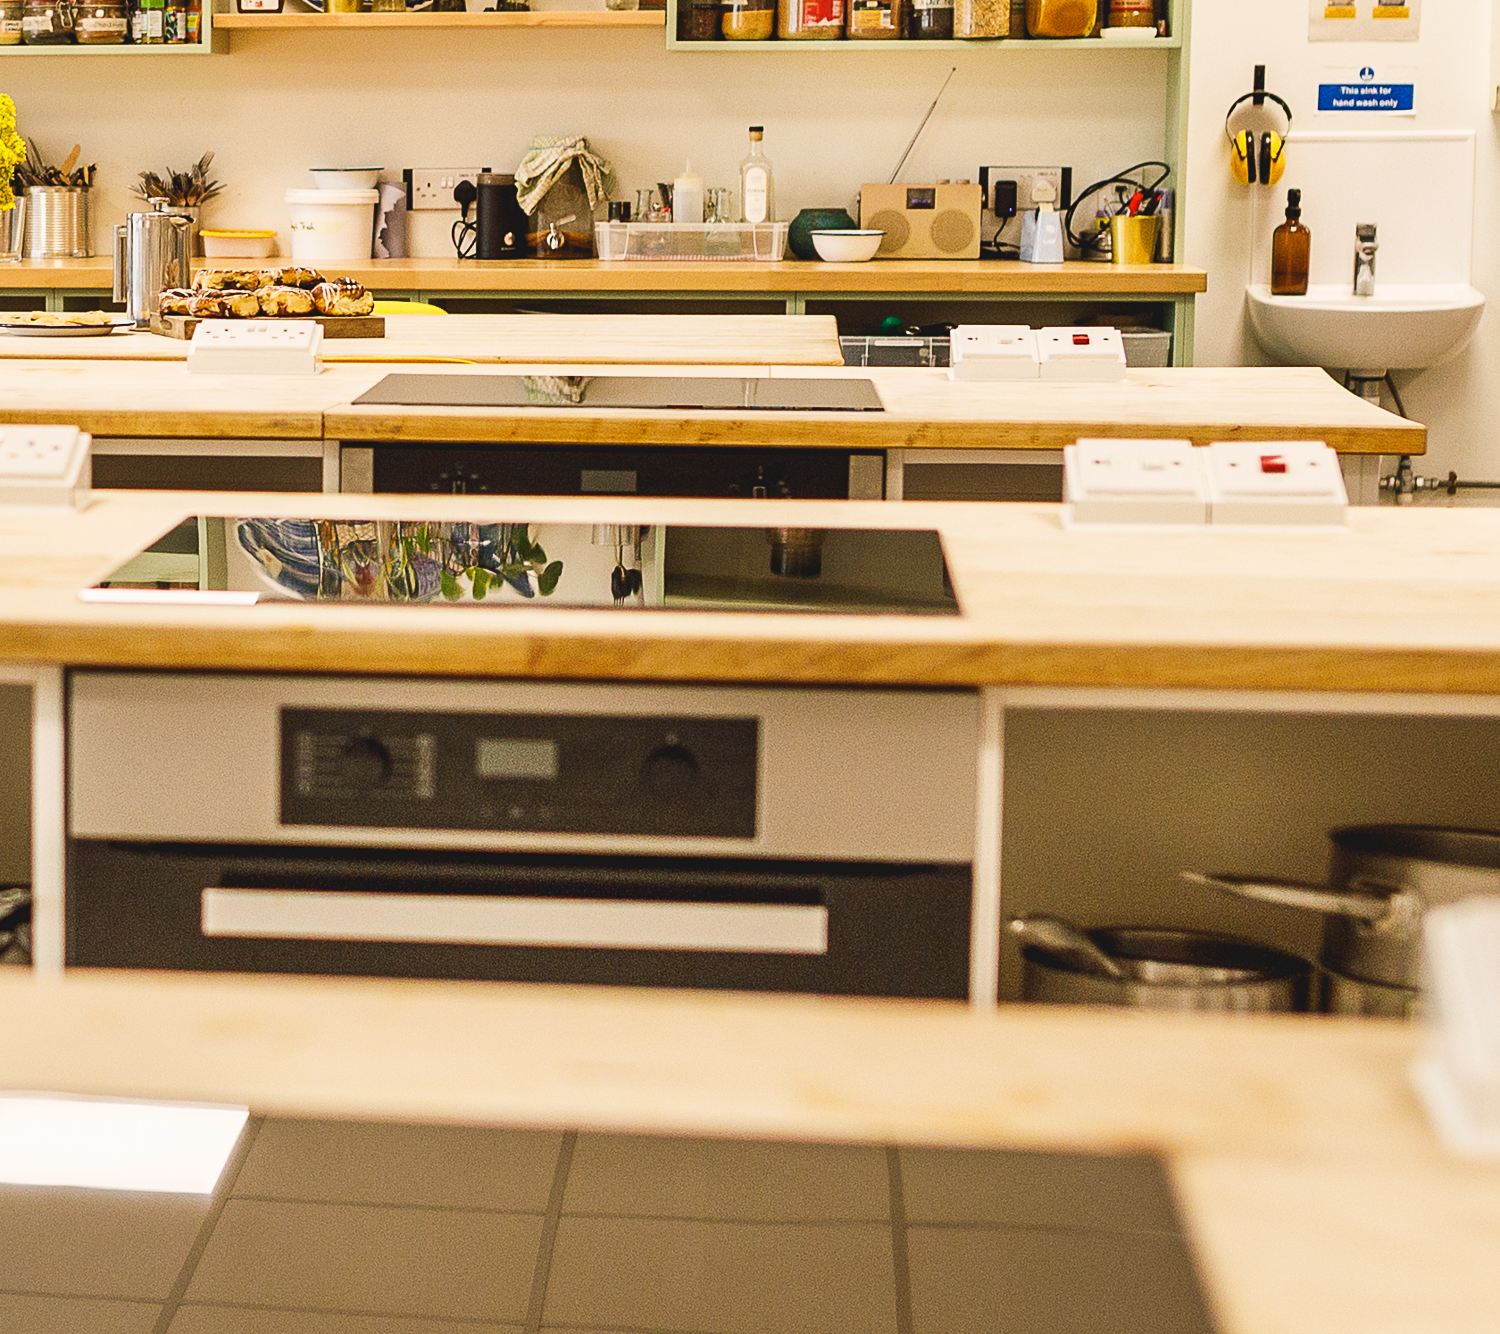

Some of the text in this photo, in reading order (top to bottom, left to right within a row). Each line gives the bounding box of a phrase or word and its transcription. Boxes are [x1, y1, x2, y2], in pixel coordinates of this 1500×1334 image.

[1340, 86, 1392, 95] This sink for
[1332, 98, 1398, 108] hand wash only
